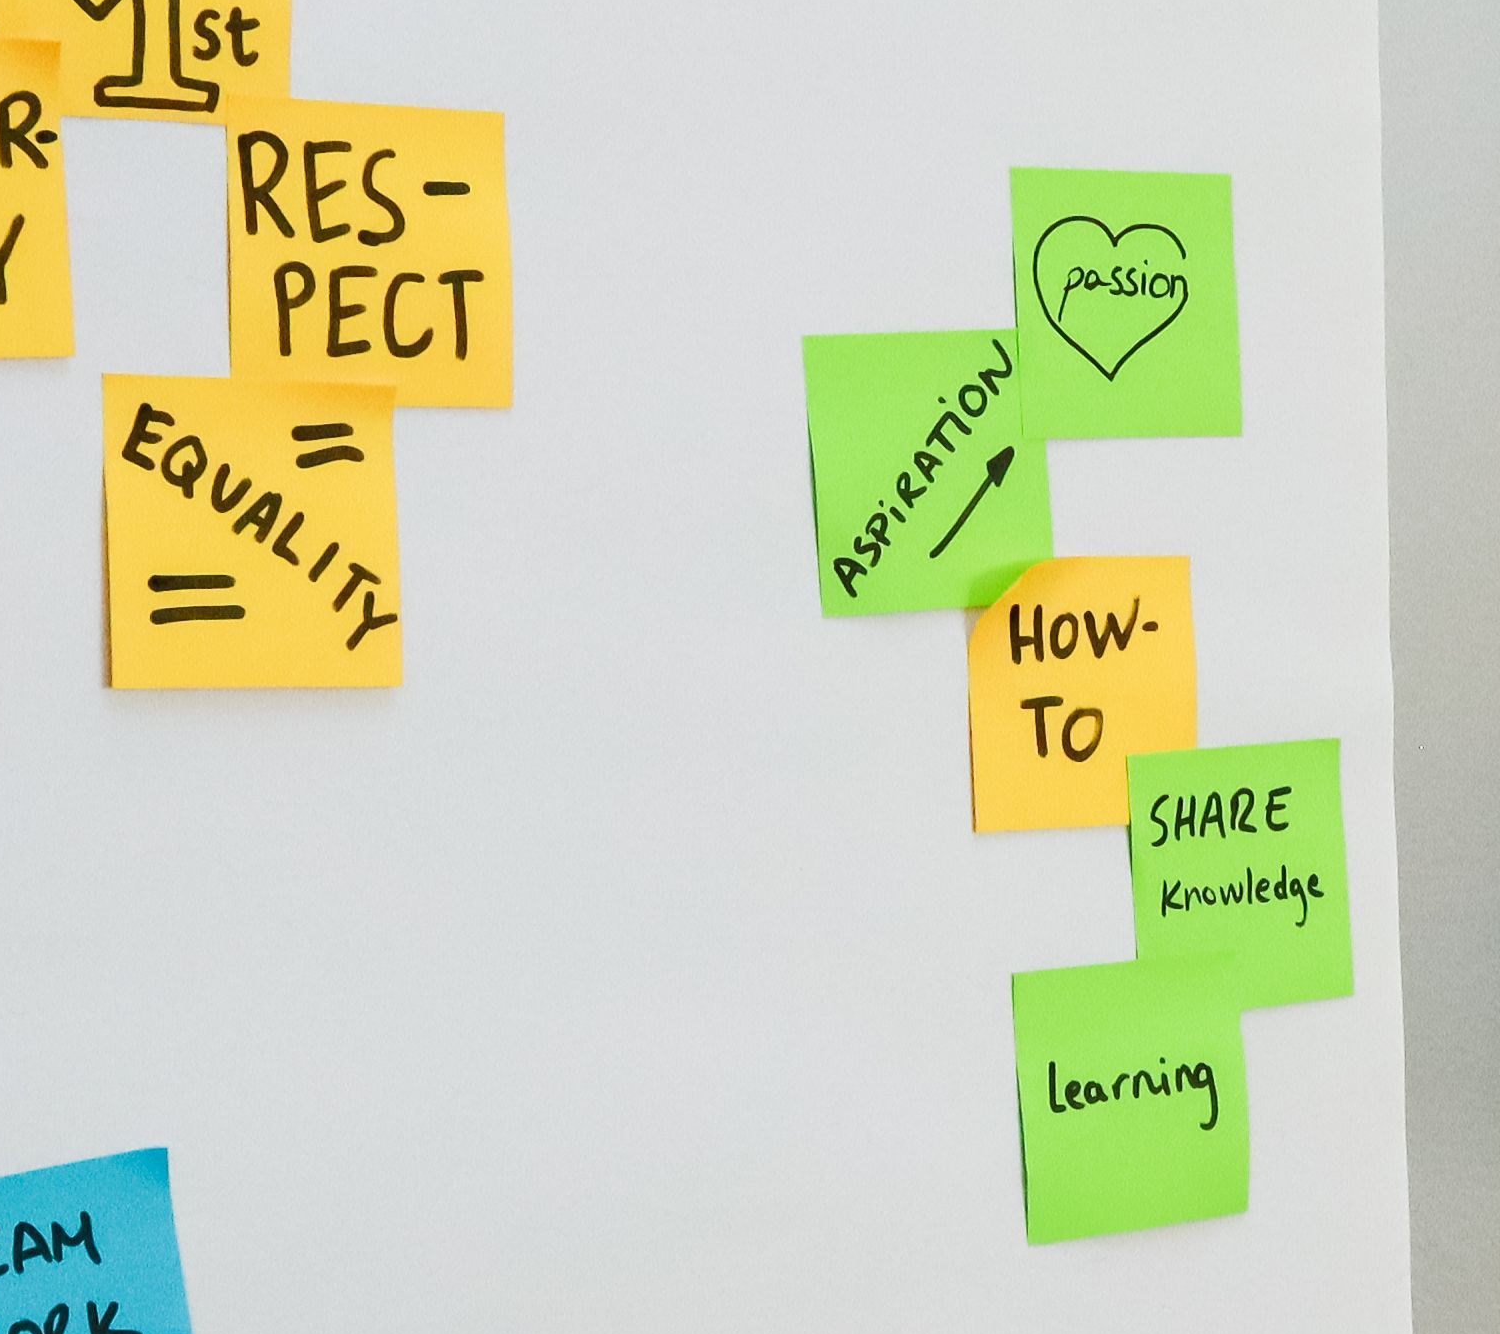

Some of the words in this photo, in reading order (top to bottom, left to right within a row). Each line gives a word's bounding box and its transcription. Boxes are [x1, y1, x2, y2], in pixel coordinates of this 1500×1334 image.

[239, 130, 471, 246] RES-
[273, 261, 485, 361] PECT
[1058, 259, 1188, 322] passion
[121, 402, 399, 651] EQUALITY
[1009, 596, 1159, 665] HOW-
[1020, 695, 1104, 762] TO
[1149, 786, 1293, 847] SHARE
